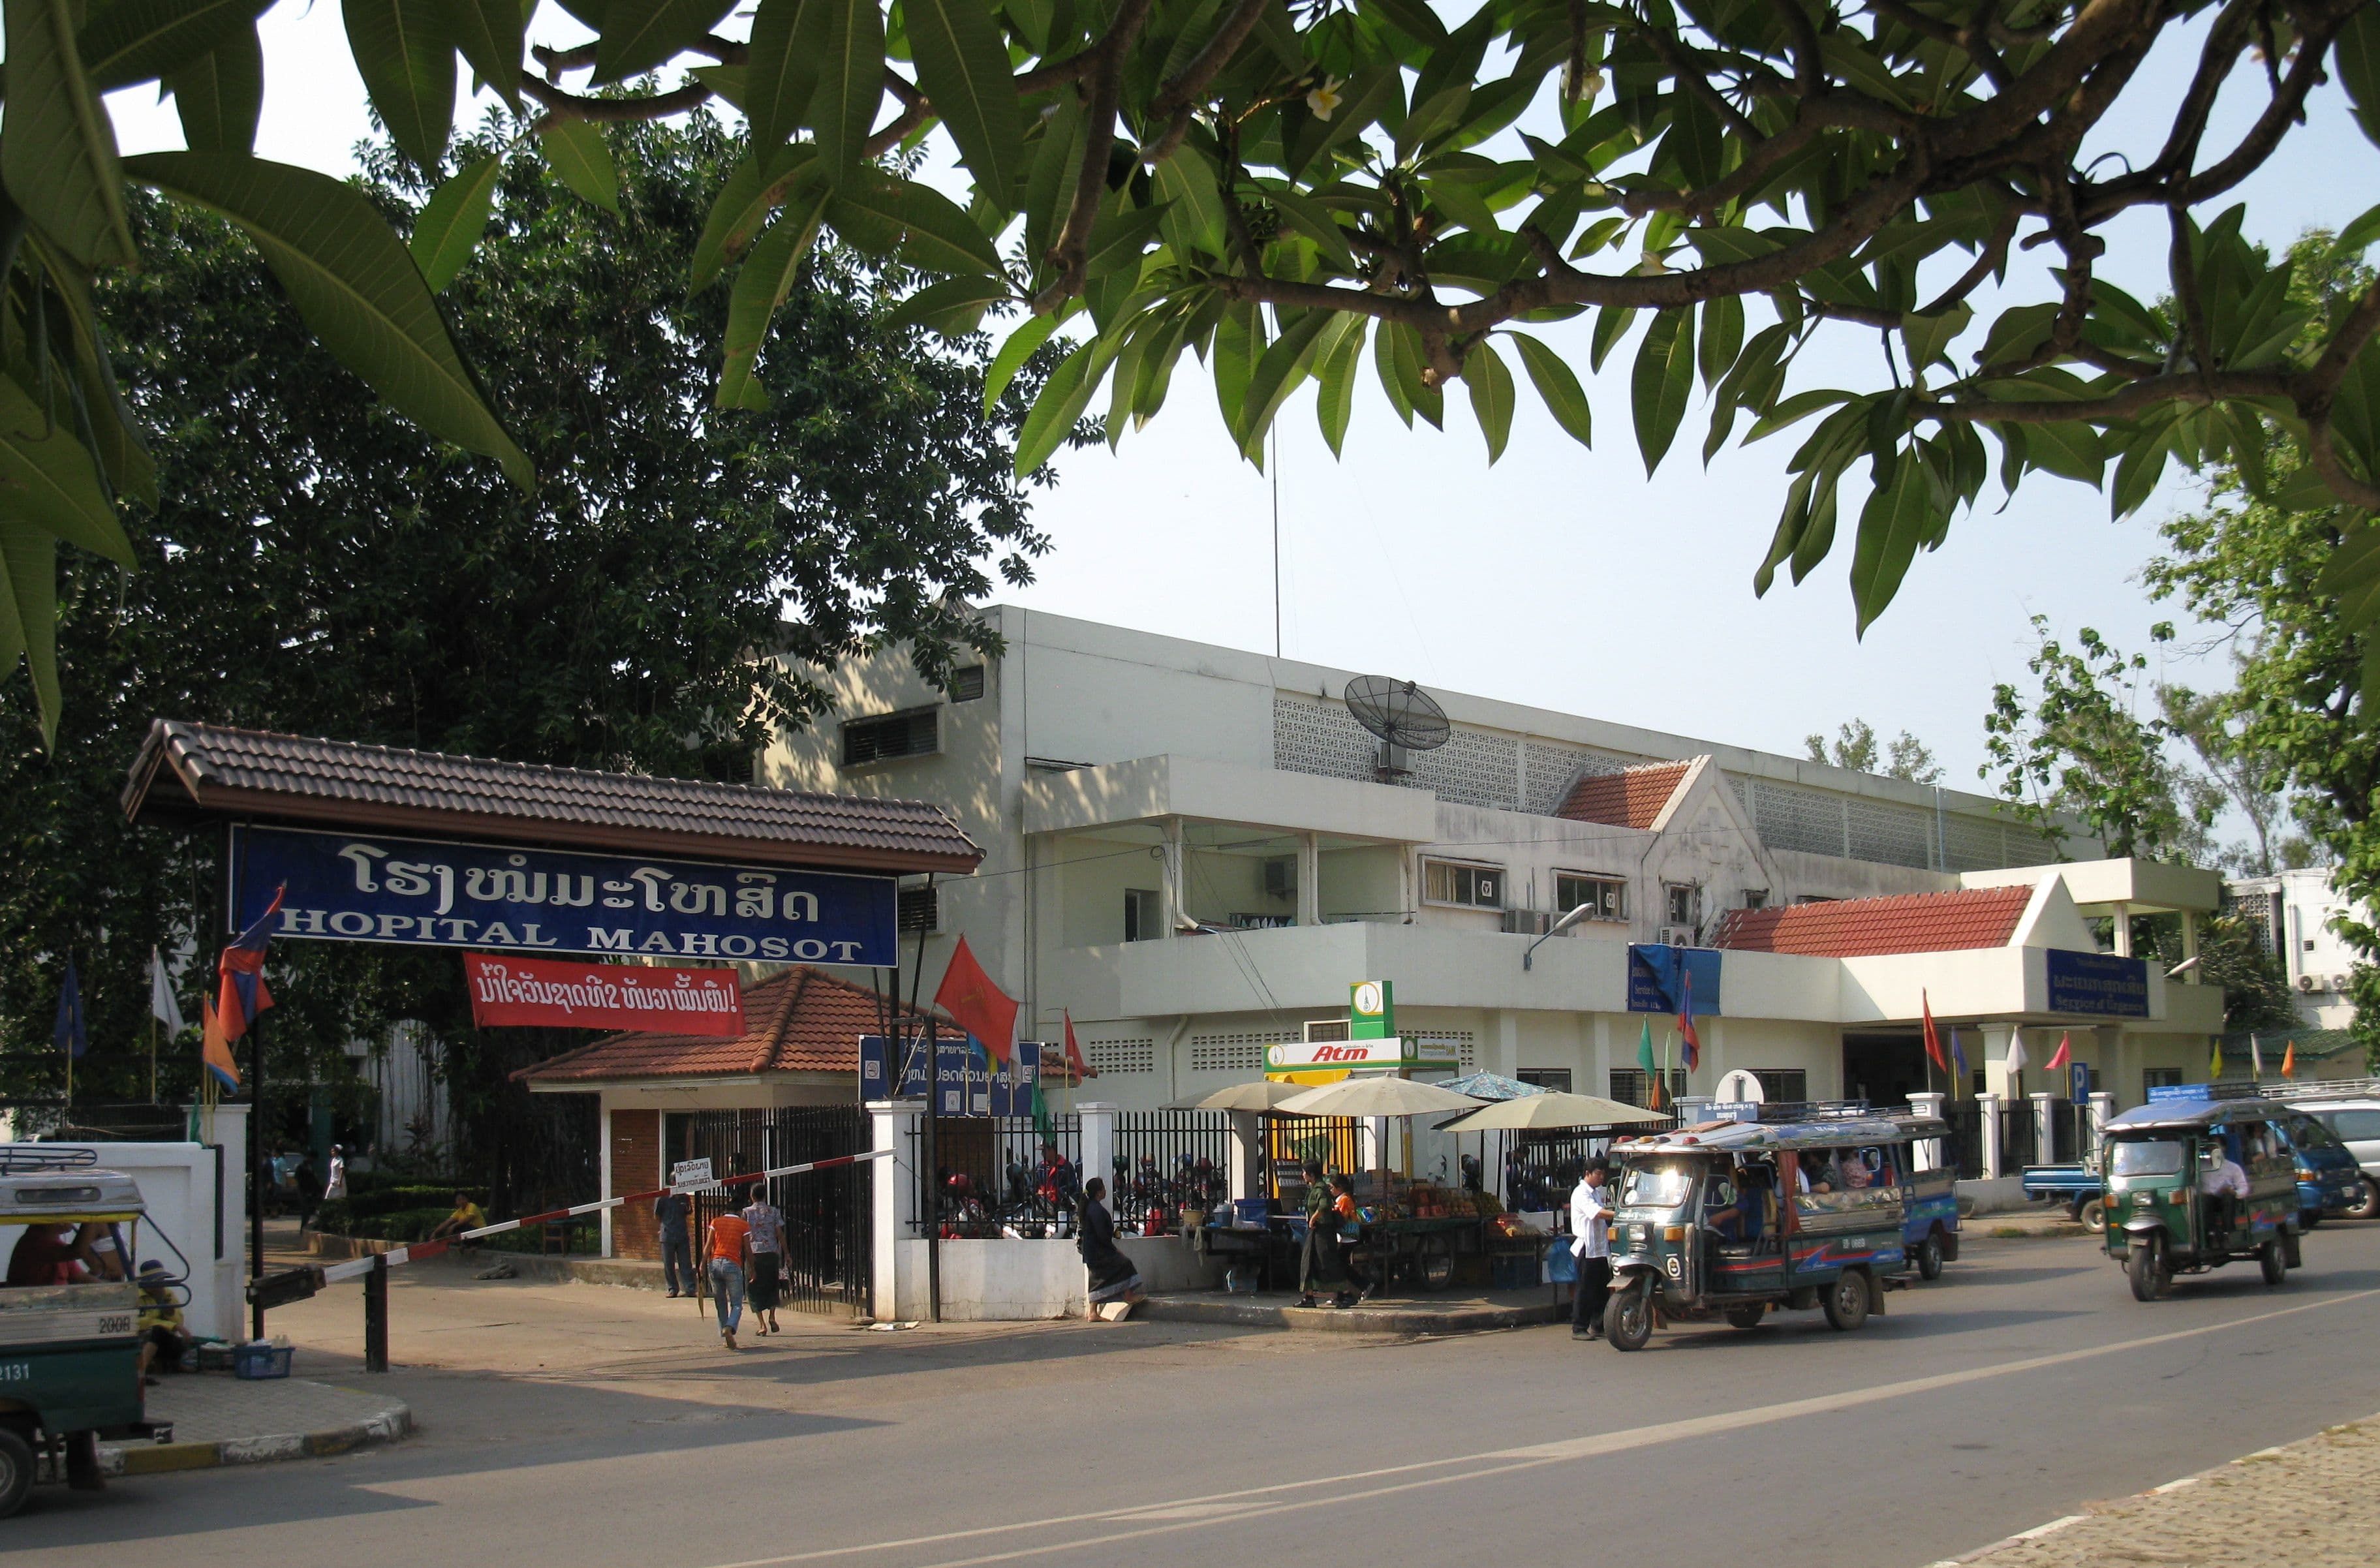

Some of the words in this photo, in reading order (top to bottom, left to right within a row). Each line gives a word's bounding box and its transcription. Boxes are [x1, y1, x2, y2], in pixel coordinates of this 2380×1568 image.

[280, 908, 558, 947] HOPITAL
[587, 927, 863, 961] MAHOSOT
[2075, 1065, 2085, 1102] P
